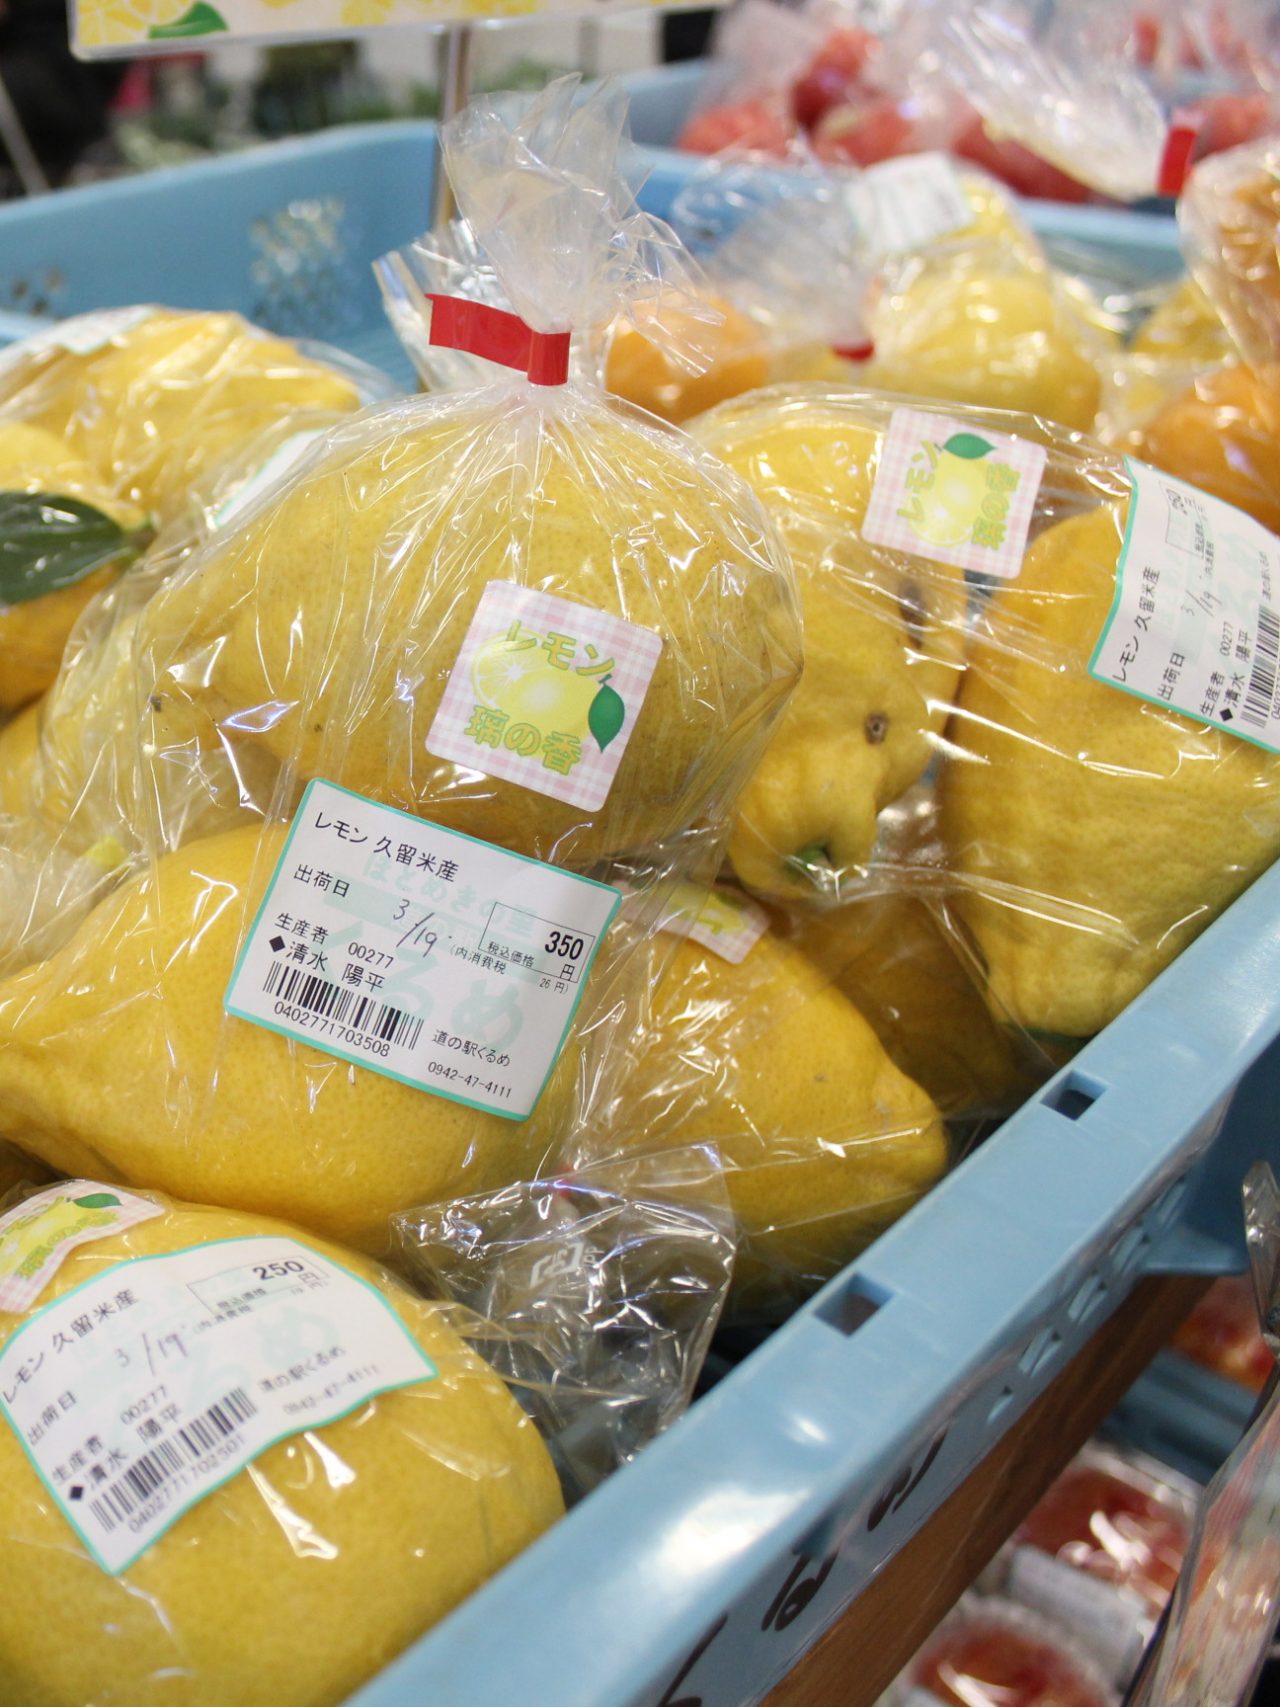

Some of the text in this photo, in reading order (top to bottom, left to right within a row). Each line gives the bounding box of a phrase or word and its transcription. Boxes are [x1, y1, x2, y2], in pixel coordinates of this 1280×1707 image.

[896, 439, 939, 522] レモン
[504, 618, 617, 677] レモン
[1112, 636, 1140, 683] レモン
[1157, 651, 1185, 701] 出荷日
[1200, 670, 1225, 718] 生産者
[314, 811, 460, 884] レモン 久留米産
[293, 863, 351, 898] 出荷日
[274, 912, 395, 970] 生産者 00277
[487, 940, 576, 982] 税込価格 円
[544, 930, 584, 961] 350
[285, 940, 386, 993] 清水 陽平
[273, 1000, 391, 1058] 0402771703508
[430, 1029, 512, 1068] 道の駅くるめ
[427, 1060, 513, 1099] 0942-47-4111
[252, 1259, 305, 1281] 250
[3, 1288, 139, 1404] レモン 久留米産
[27, 1389, 78, 1446] 出荷日
[120, 1384, 168, 1426] 00277
